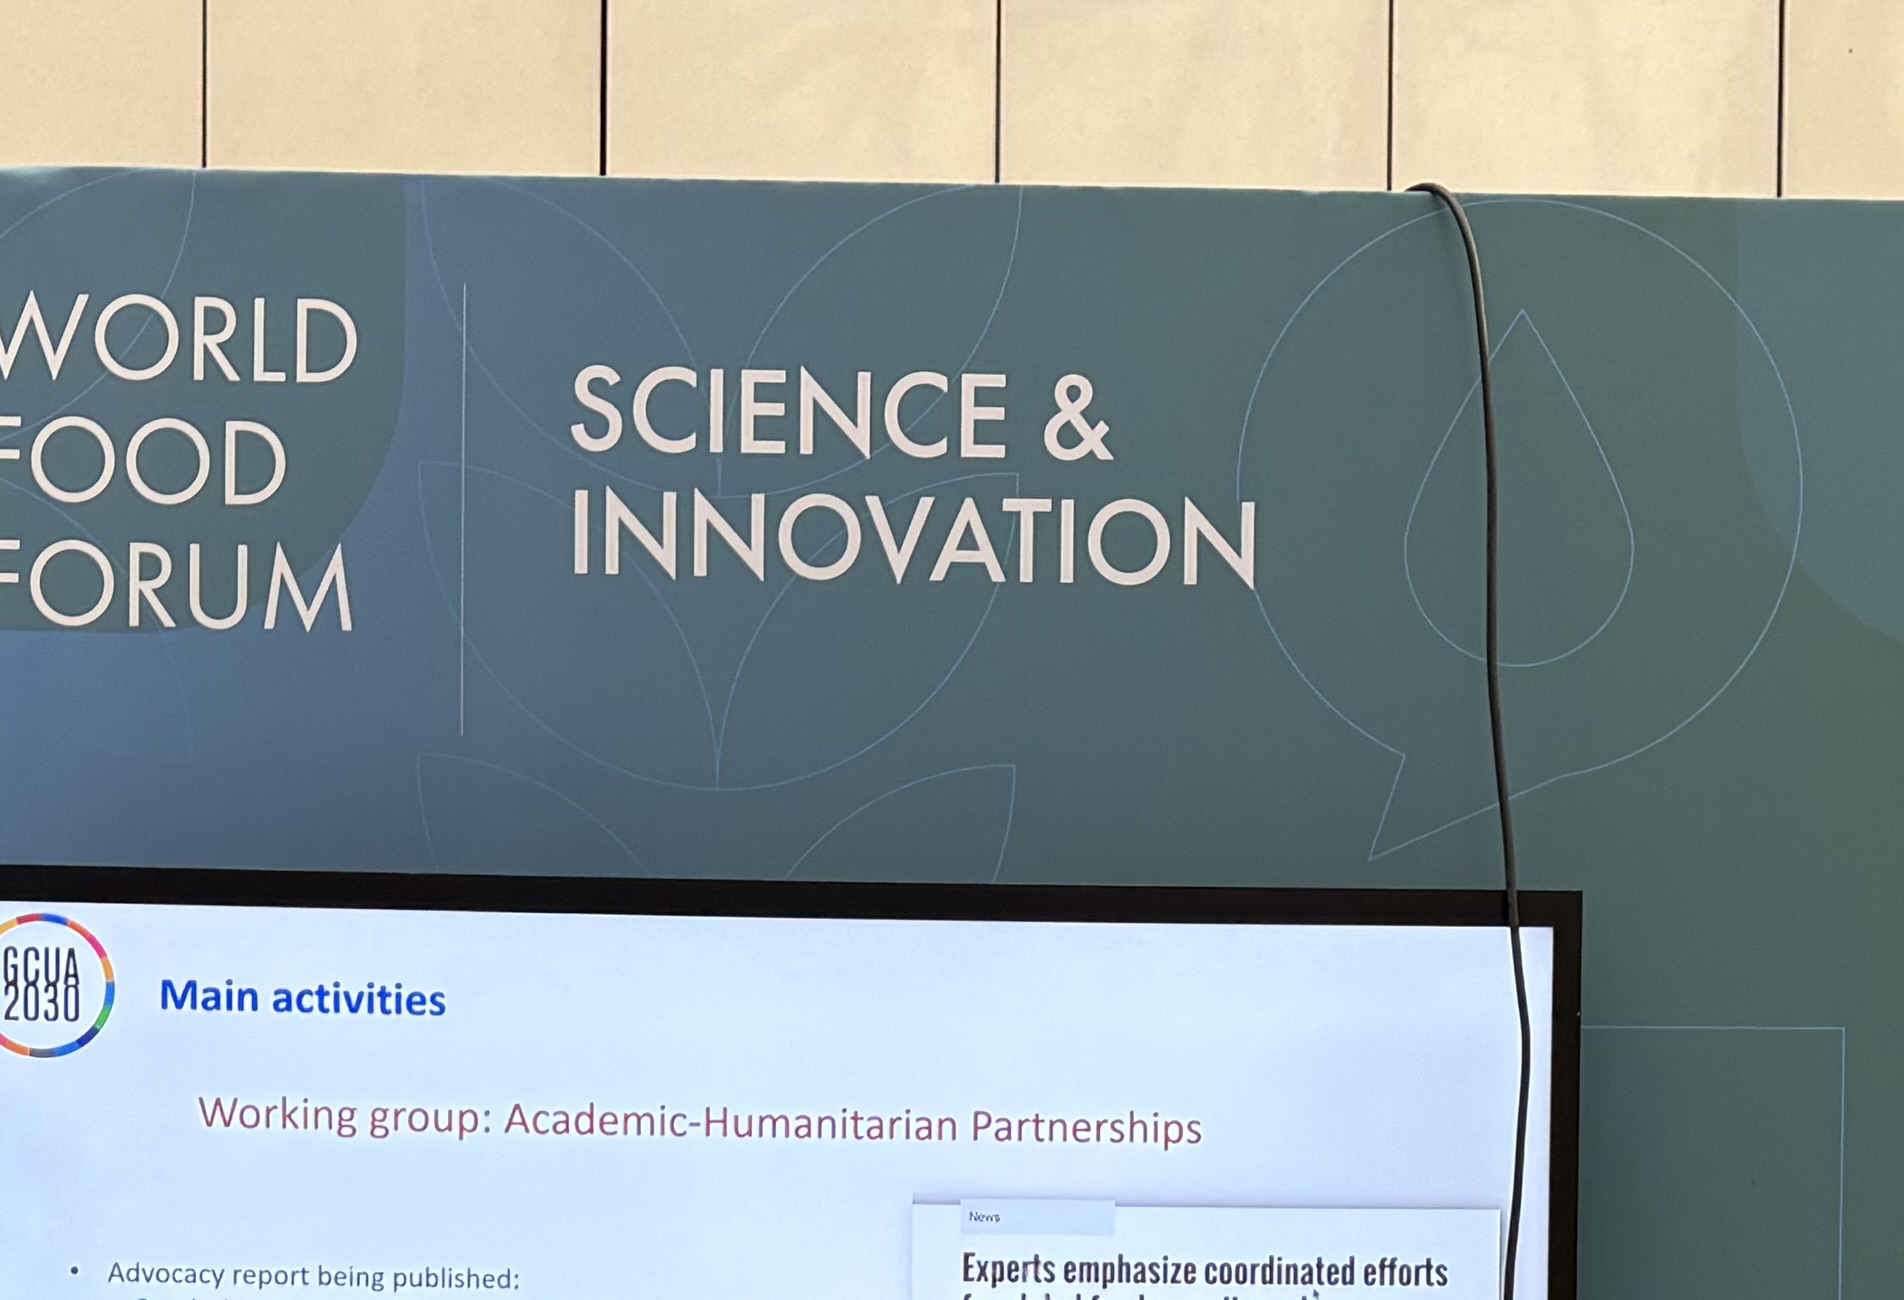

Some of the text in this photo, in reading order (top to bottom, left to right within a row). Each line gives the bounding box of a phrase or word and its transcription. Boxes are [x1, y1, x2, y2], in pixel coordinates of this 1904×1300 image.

[571, 365, 1113, 460] SCIENCE &
[575, 486, 1255, 590] INNOVATION
[3, 945, 80, 984] GCUA
[3, 981, 80, 1022] 2030
[161, 978, 445, 1017] Main activities
[199, 1096, 1201, 1152] Working group: Academic-Humanitarian Partnerships
[108, 1262, 518, 1293] Advocacy report being published:
[963, 1253, 1447, 1289] Experts emphasize coordinated efforts
